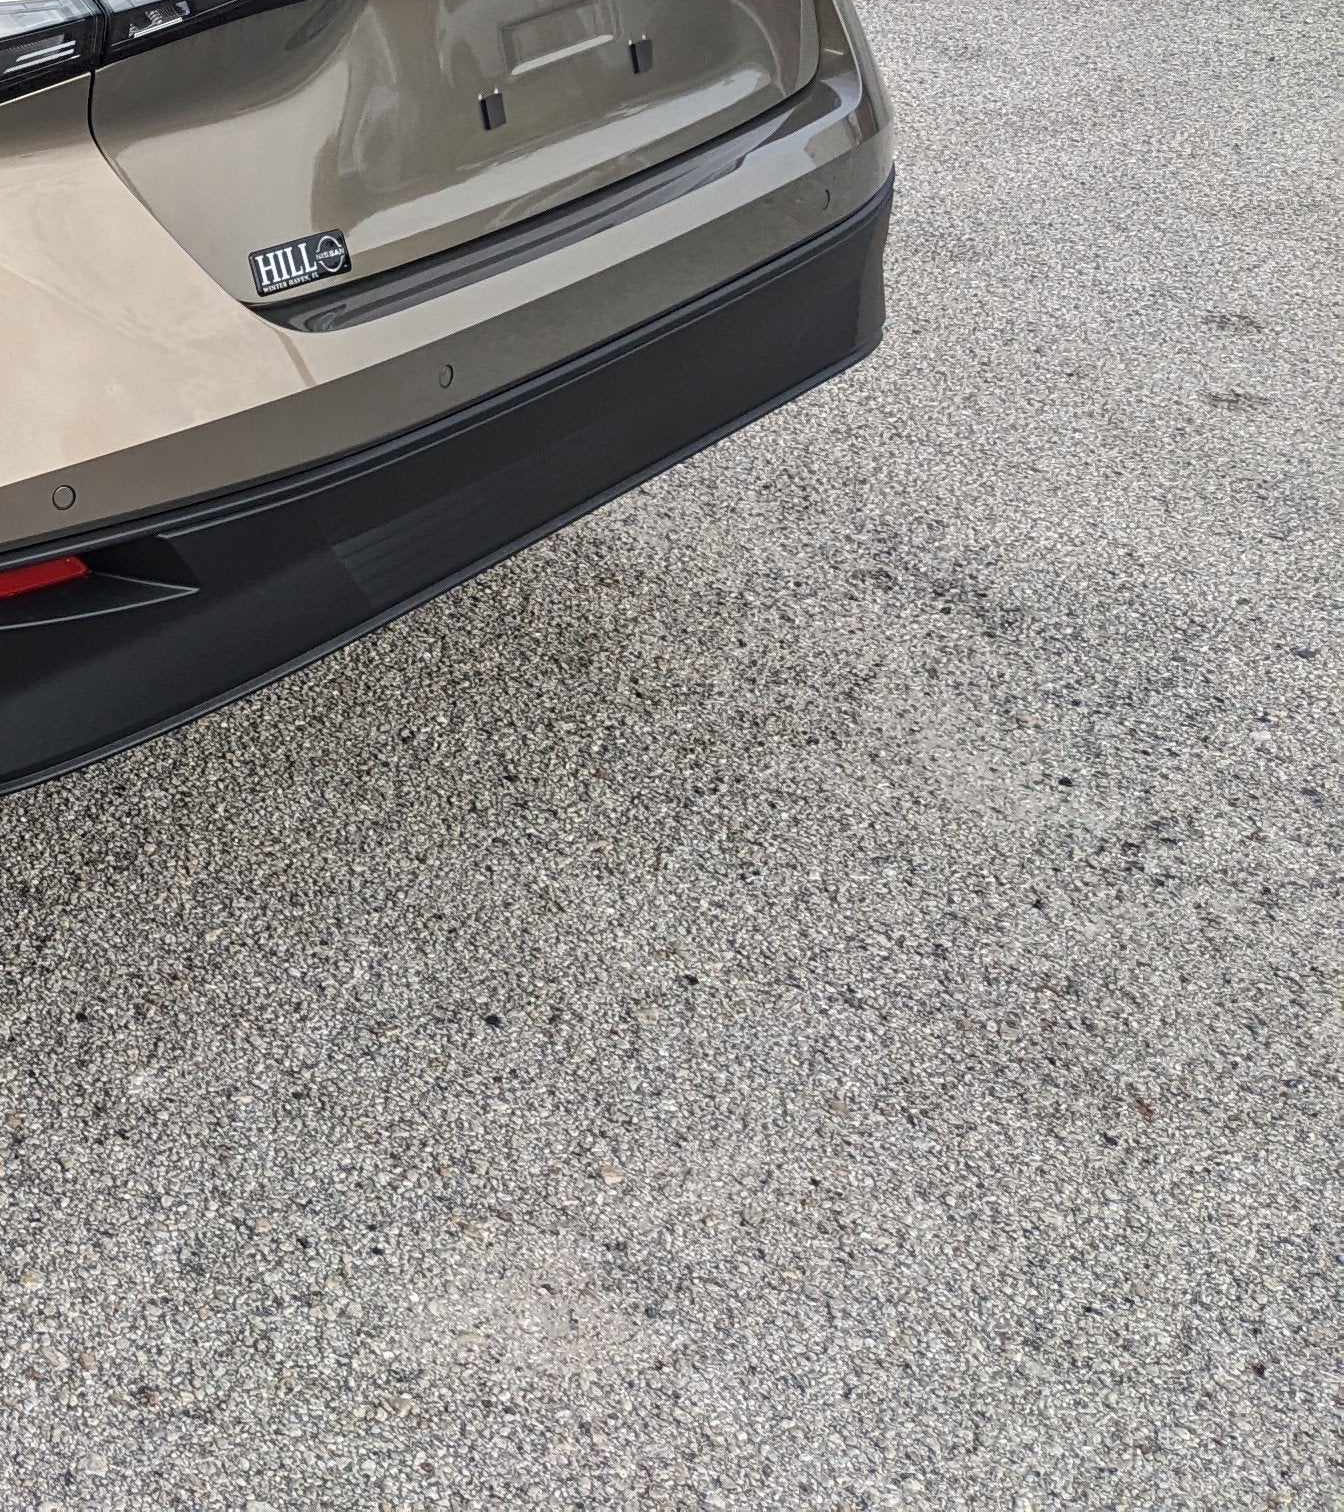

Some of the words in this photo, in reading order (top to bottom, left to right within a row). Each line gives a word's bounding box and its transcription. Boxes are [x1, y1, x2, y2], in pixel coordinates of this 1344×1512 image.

[255, 243, 318, 286] HILL
[316, 248, 345, 259] NISSAN
[263, 281, 288, 293] WINTER
